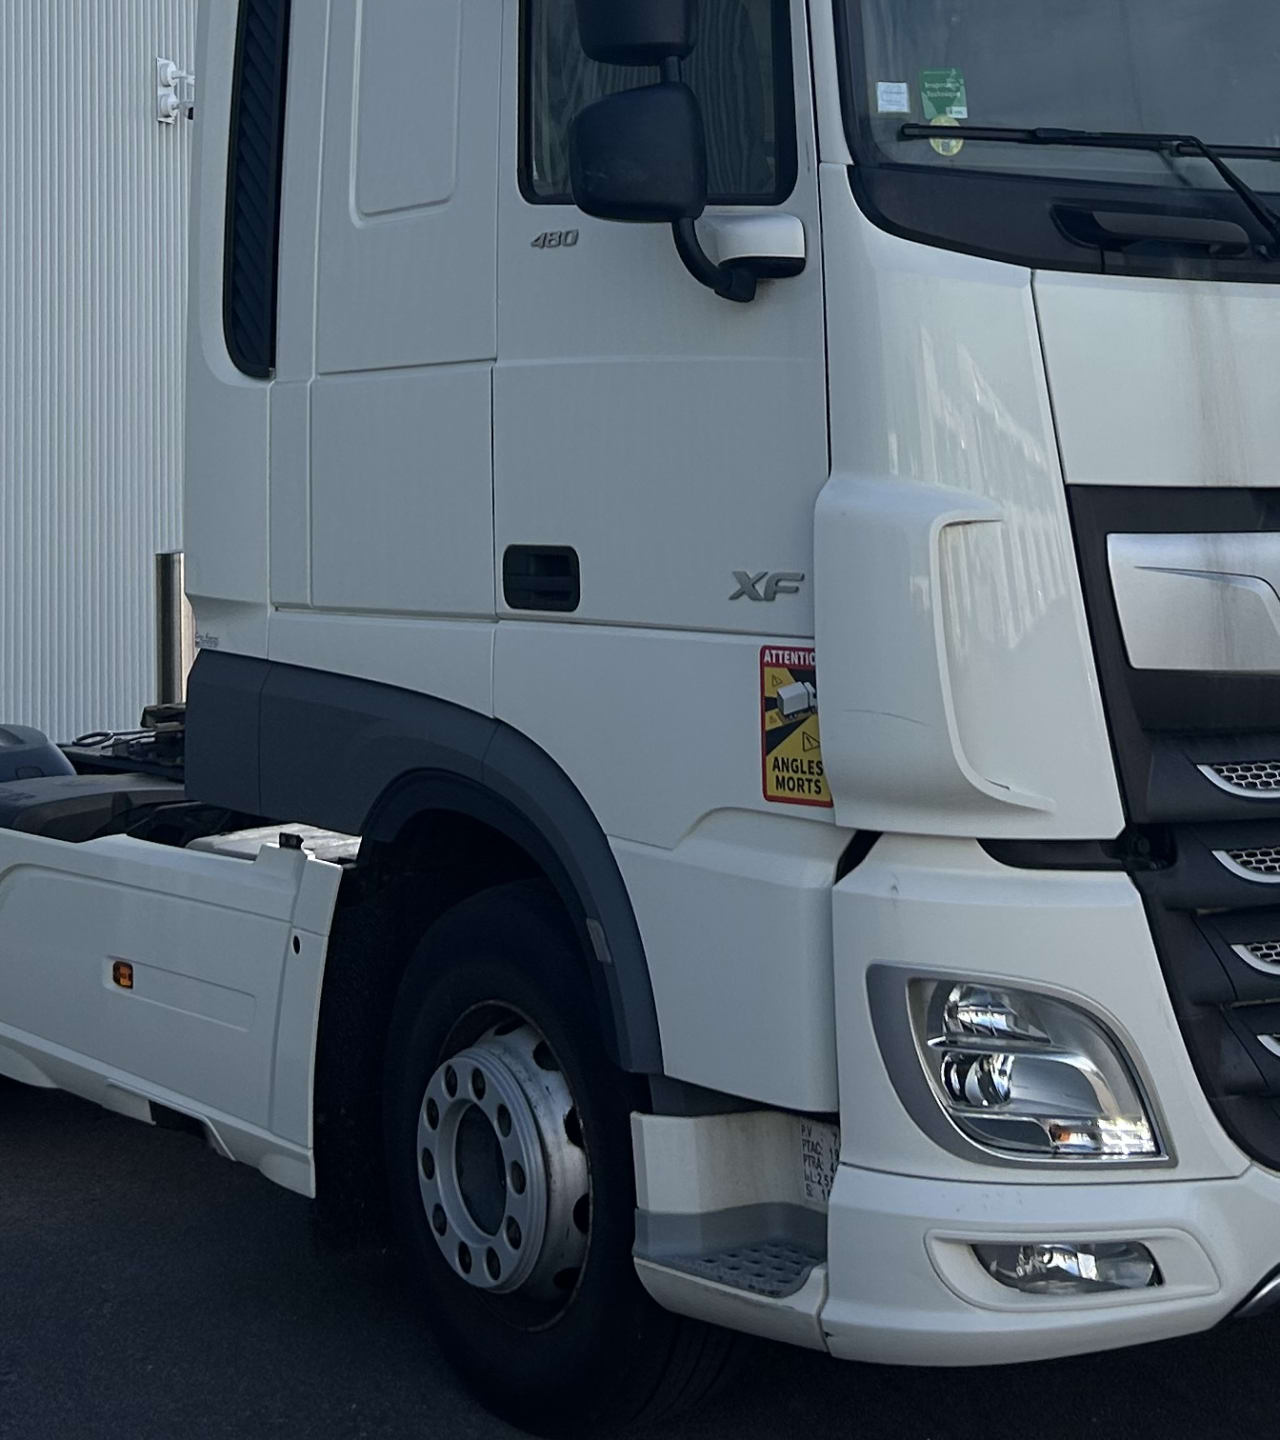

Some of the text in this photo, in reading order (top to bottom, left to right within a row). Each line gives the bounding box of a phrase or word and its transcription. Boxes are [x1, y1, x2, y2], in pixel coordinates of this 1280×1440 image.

[530, 229, 579, 249] 480
[728, 571, 805, 601] XF
[764, 649, 816, 665] ATTENTIO
[772, 756, 824, 777] ANGLES
[775, 775, 822, 795] MORTS
